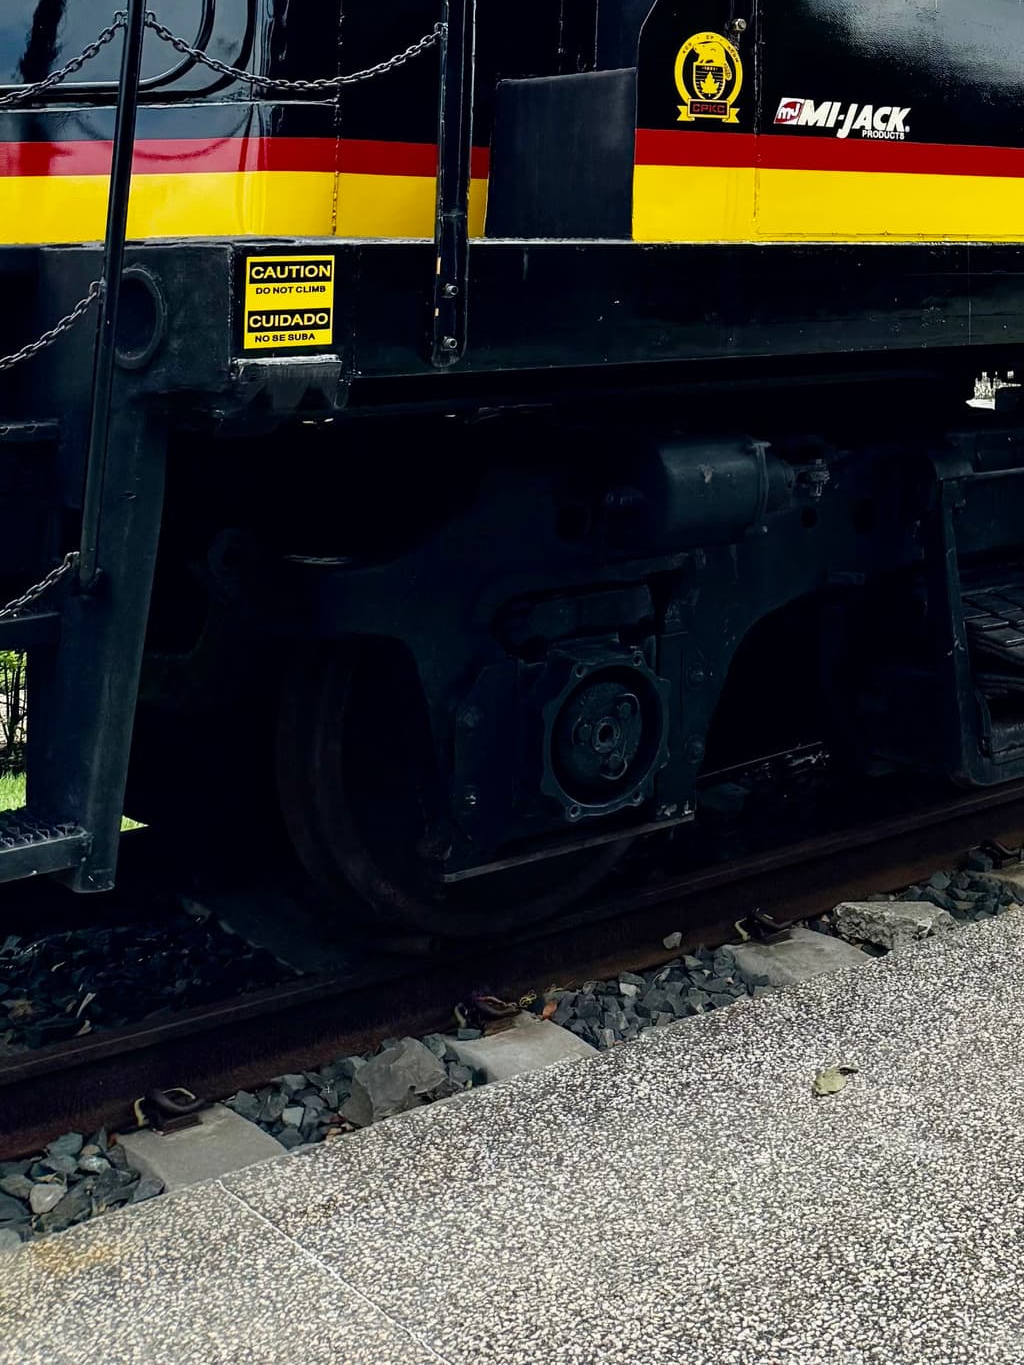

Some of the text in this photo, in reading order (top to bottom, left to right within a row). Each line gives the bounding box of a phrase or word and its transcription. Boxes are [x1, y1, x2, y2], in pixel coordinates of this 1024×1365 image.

[692, 103, 725, 114] CPKC
[861, 129, 905, 140] PRODUCTS
[251, 265, 330, 279] CAUTION
[256, 285, 326, 295] DO NOT CLIMB
[249, 313, 328, 328] CUIDADO
[255, 332, 315, 343] NO SE SUBA
